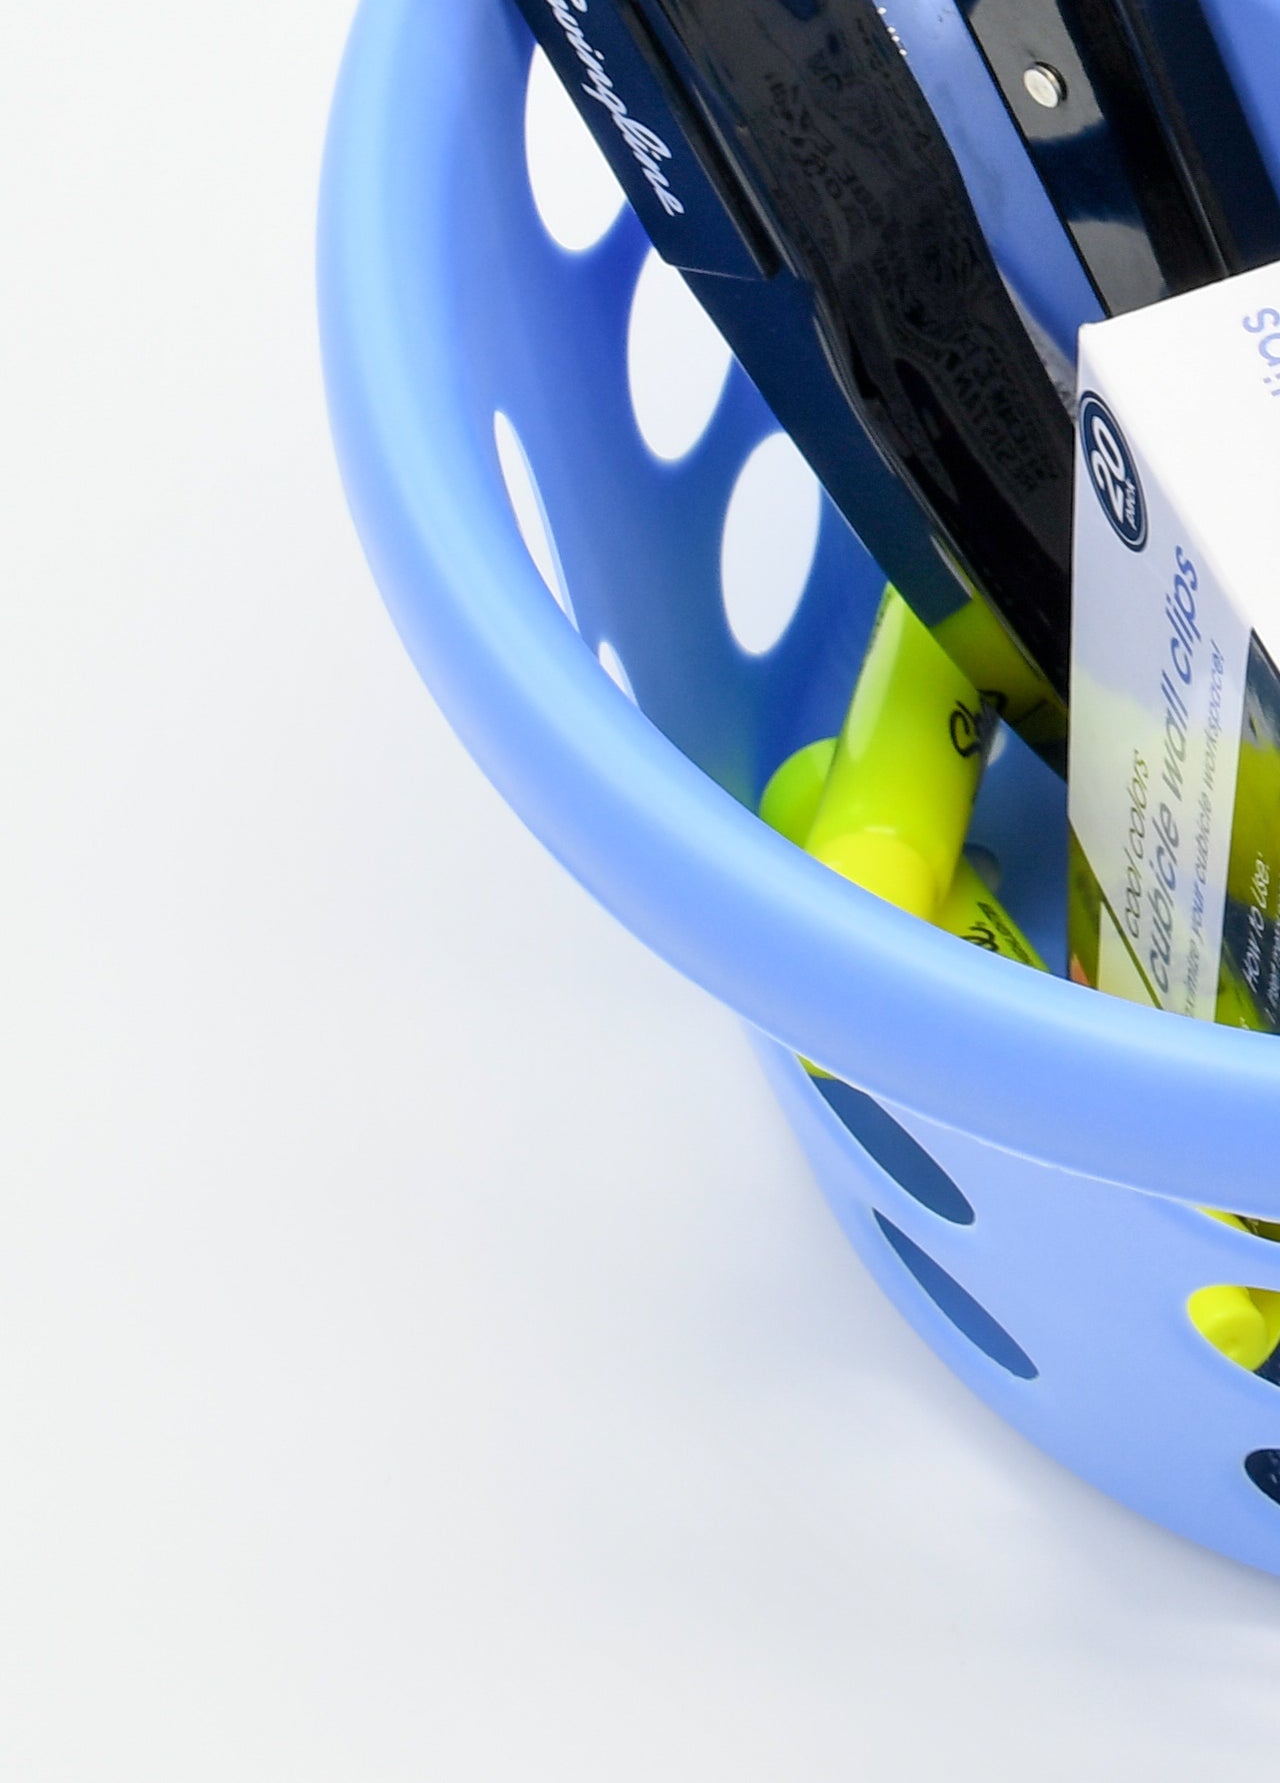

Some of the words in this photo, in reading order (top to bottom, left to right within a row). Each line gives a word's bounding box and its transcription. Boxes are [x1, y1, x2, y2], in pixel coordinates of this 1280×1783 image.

[1091, 415, 1126, 524] 20
[1165, 545, 1202, 686] clips
[1160, 668, 1189, 803] wall
[1126, 748, 1150, 860] colors
[1124, 847, 1143, 940] cool
[1147, 801, 1180, 995] cubicle
[1248, 902, 1263, 937] to
